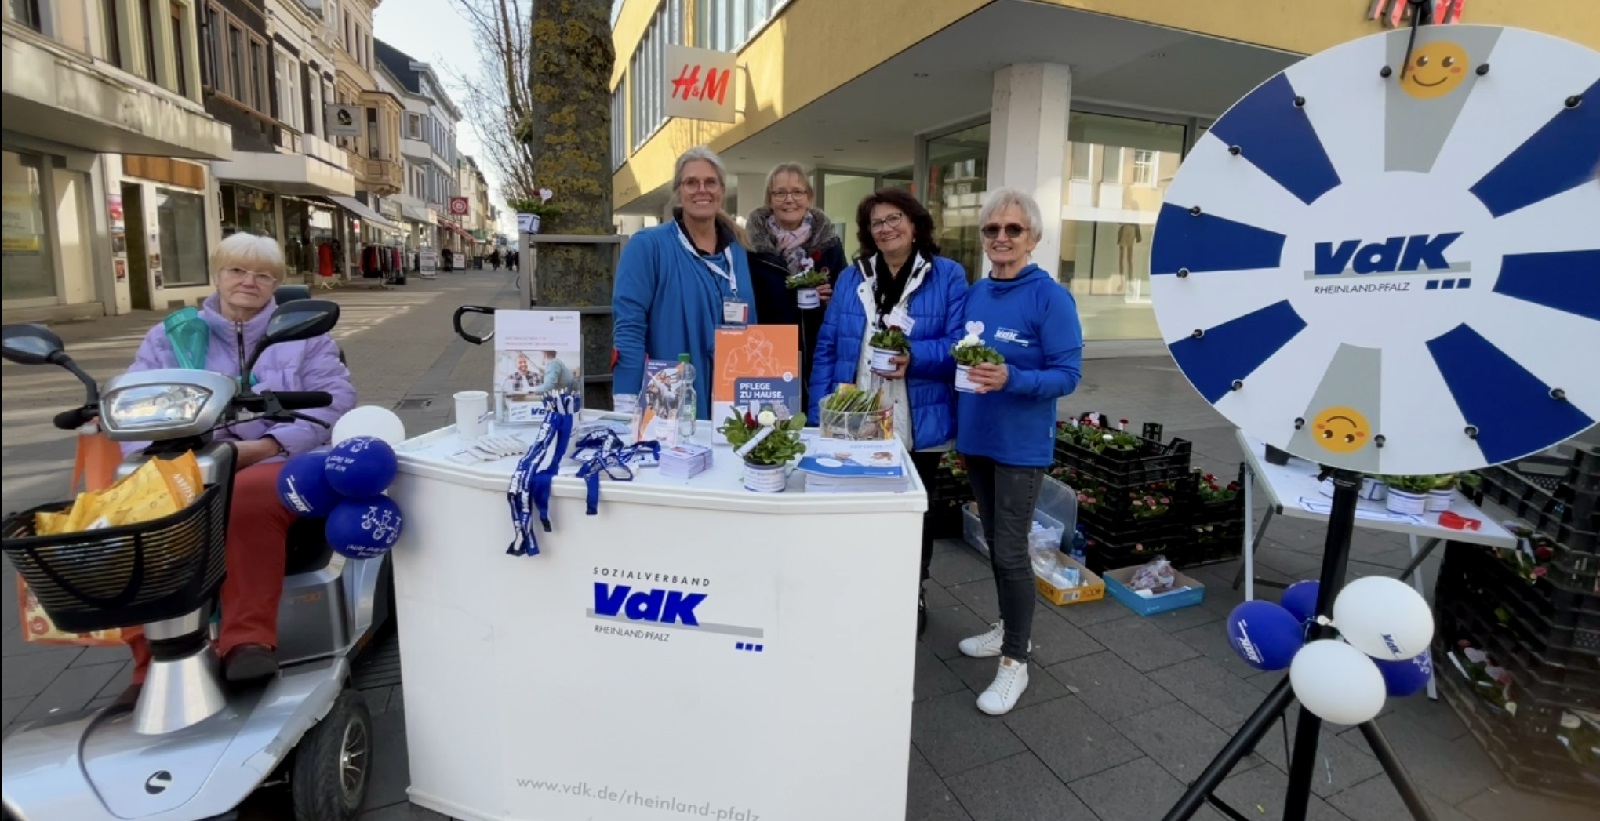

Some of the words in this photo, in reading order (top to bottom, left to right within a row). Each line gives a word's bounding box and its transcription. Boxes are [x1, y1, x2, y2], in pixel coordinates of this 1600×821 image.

[671, 63, 730, 105] H&M
[1314, 231, 1464, 275] VdK
[1314, 282, 1410, 294] RHEINLAND-PFALZ
[739, 382, 771, 390] PFLEGE
[739, 391, 752, 399] ZU
[753, 391, 785, 399] HAUSE.
[593, 566, 710, 587] SOZIALVERBAND
[594, 582, 708, 626] VdK
